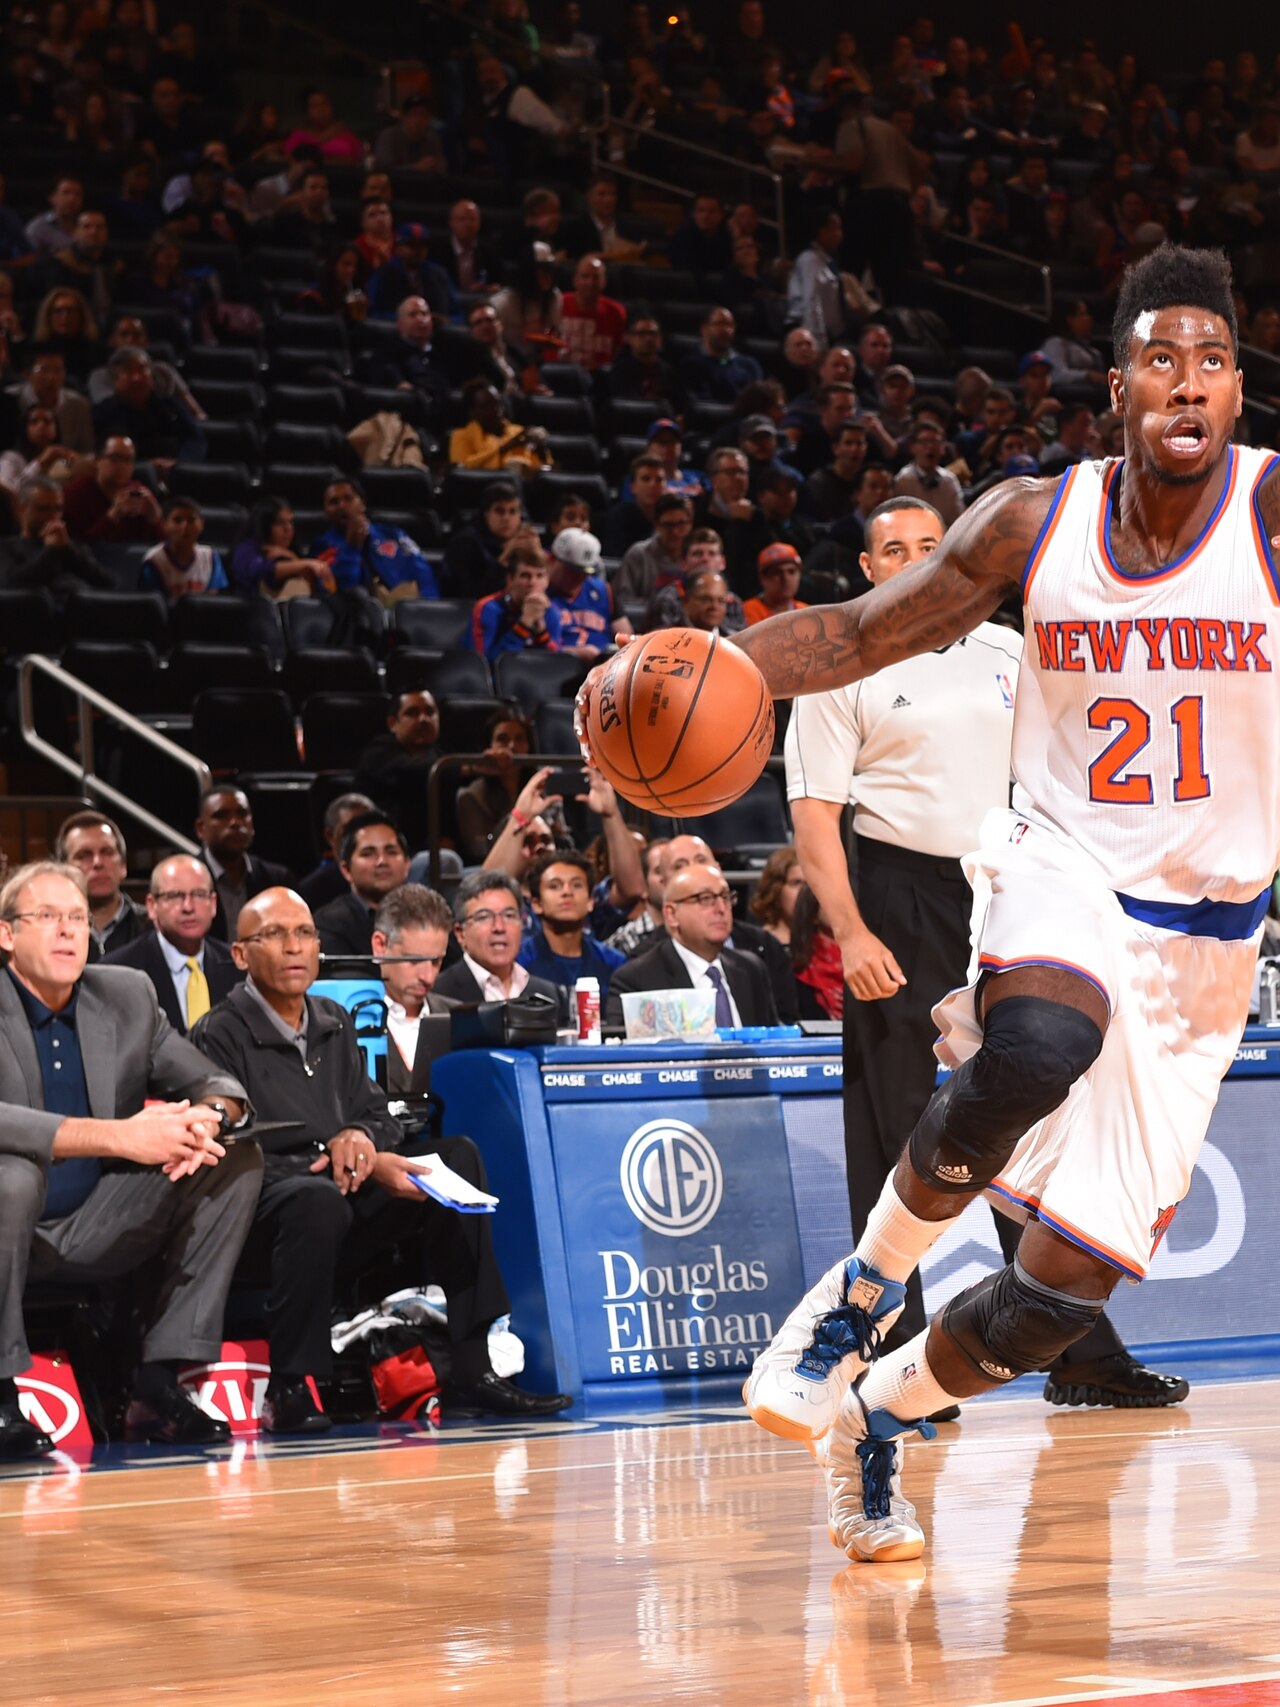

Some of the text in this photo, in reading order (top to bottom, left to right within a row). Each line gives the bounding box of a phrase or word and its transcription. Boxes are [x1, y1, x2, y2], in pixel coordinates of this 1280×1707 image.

[1034, 617, 1272, 673] NEW YORK
[1087, 695, 1212, 805] 21
[543, 1072, 585, 1086] CHASE
[601, 1071, 641, 1084] CHASE
[658, 1069, 697, 1082] CHASE
[714, 1067, 752, 1079] CHASE
[768, 1065, 808, 1077] CHASE
[597, 1244, 769, 1312] Douglas
[602, 1300, 773, 1353] Elliman
[610, 1346, 769, 1374] REAL ESTAT
